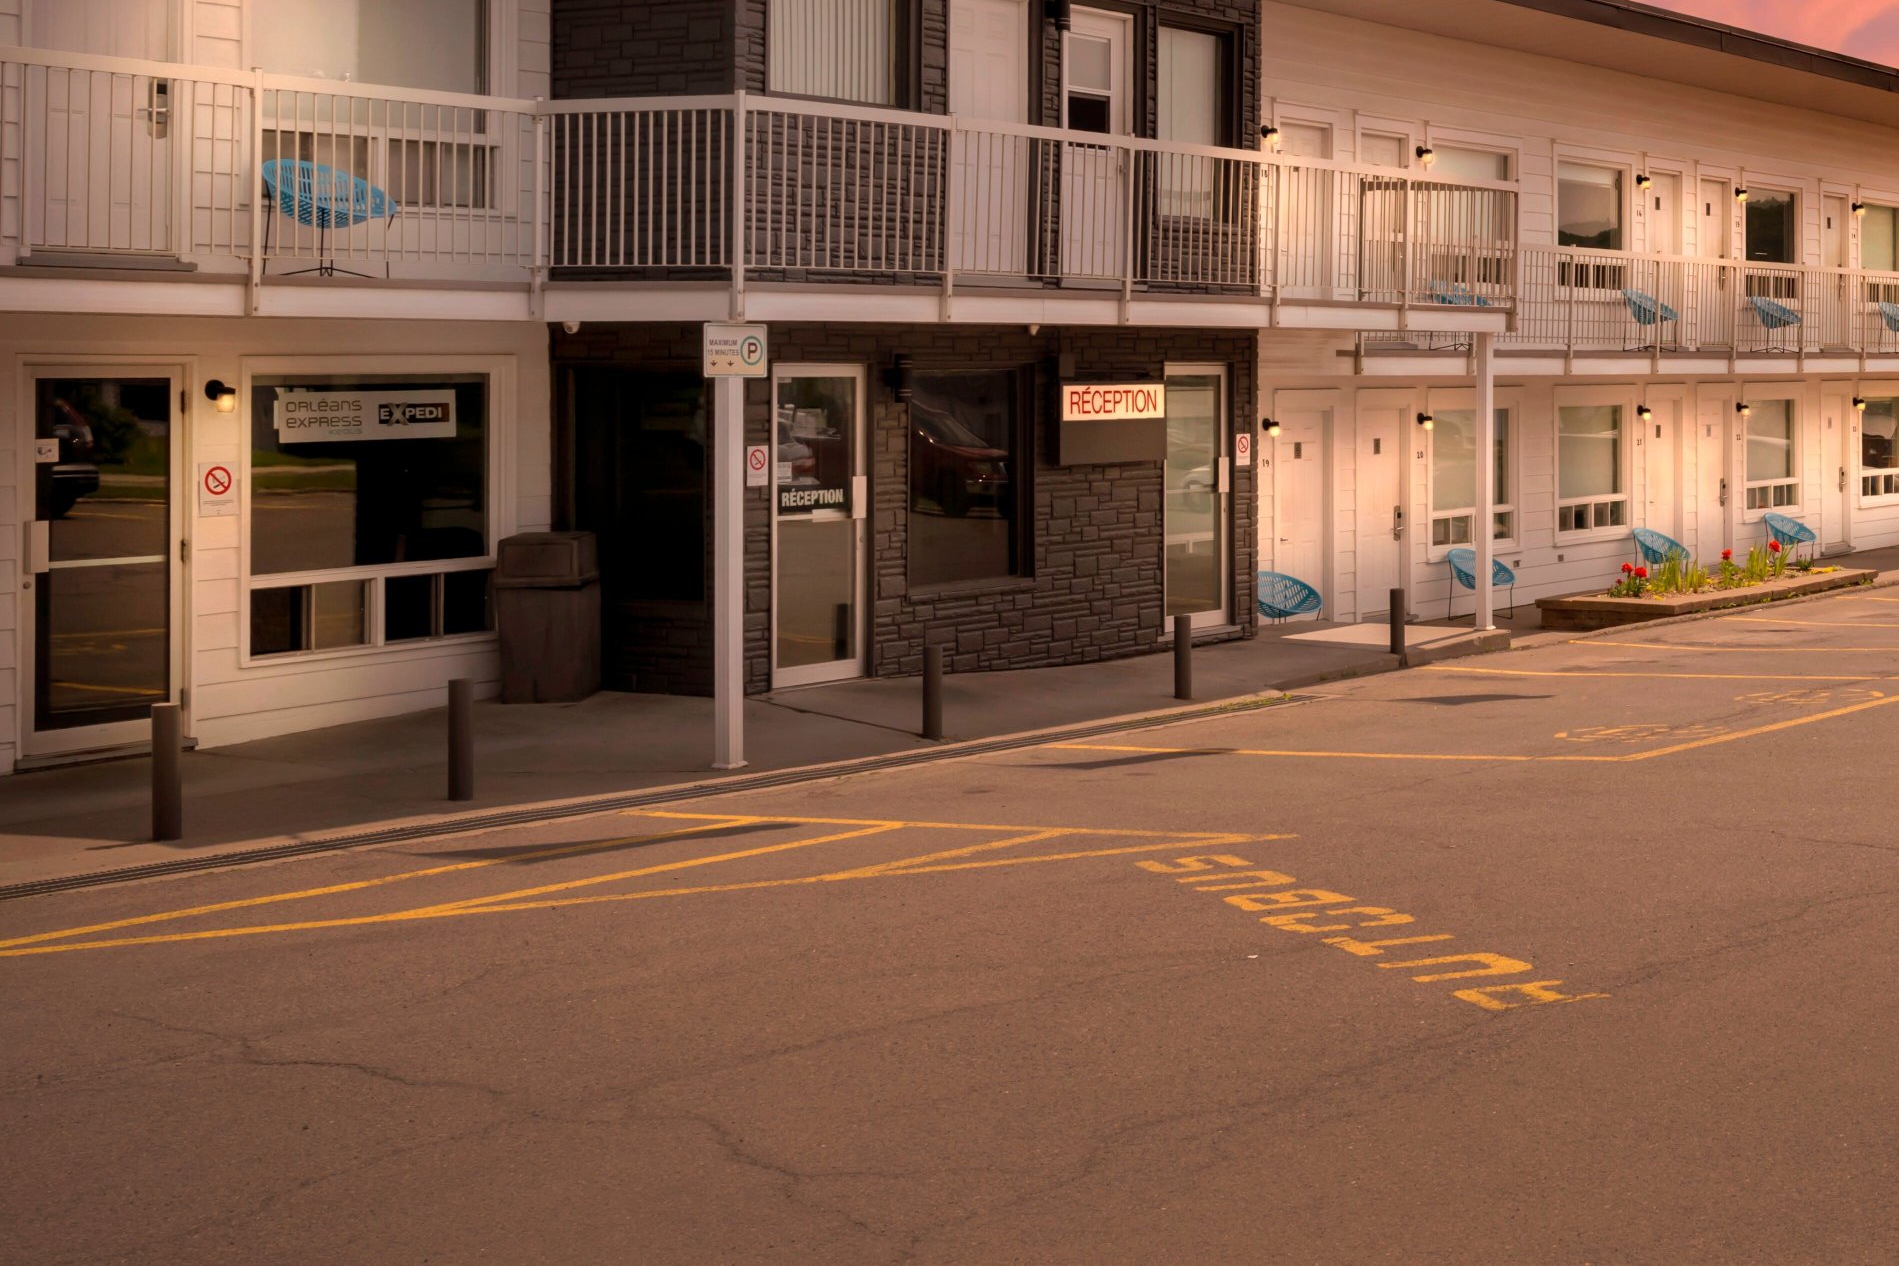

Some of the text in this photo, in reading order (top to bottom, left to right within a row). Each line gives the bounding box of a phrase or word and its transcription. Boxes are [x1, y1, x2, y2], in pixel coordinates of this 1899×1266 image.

[747, 342, 758, 360] P
[1070, 386, 1157, 415] RÉCEPTION
[380, 402, 443, 426] EXPEDI
[1262, 458, 1270, 468] 19
[781, 488, 844, 507] RÉCEPTION
[1134, 854, 1611, 1010] AUTOBUS
